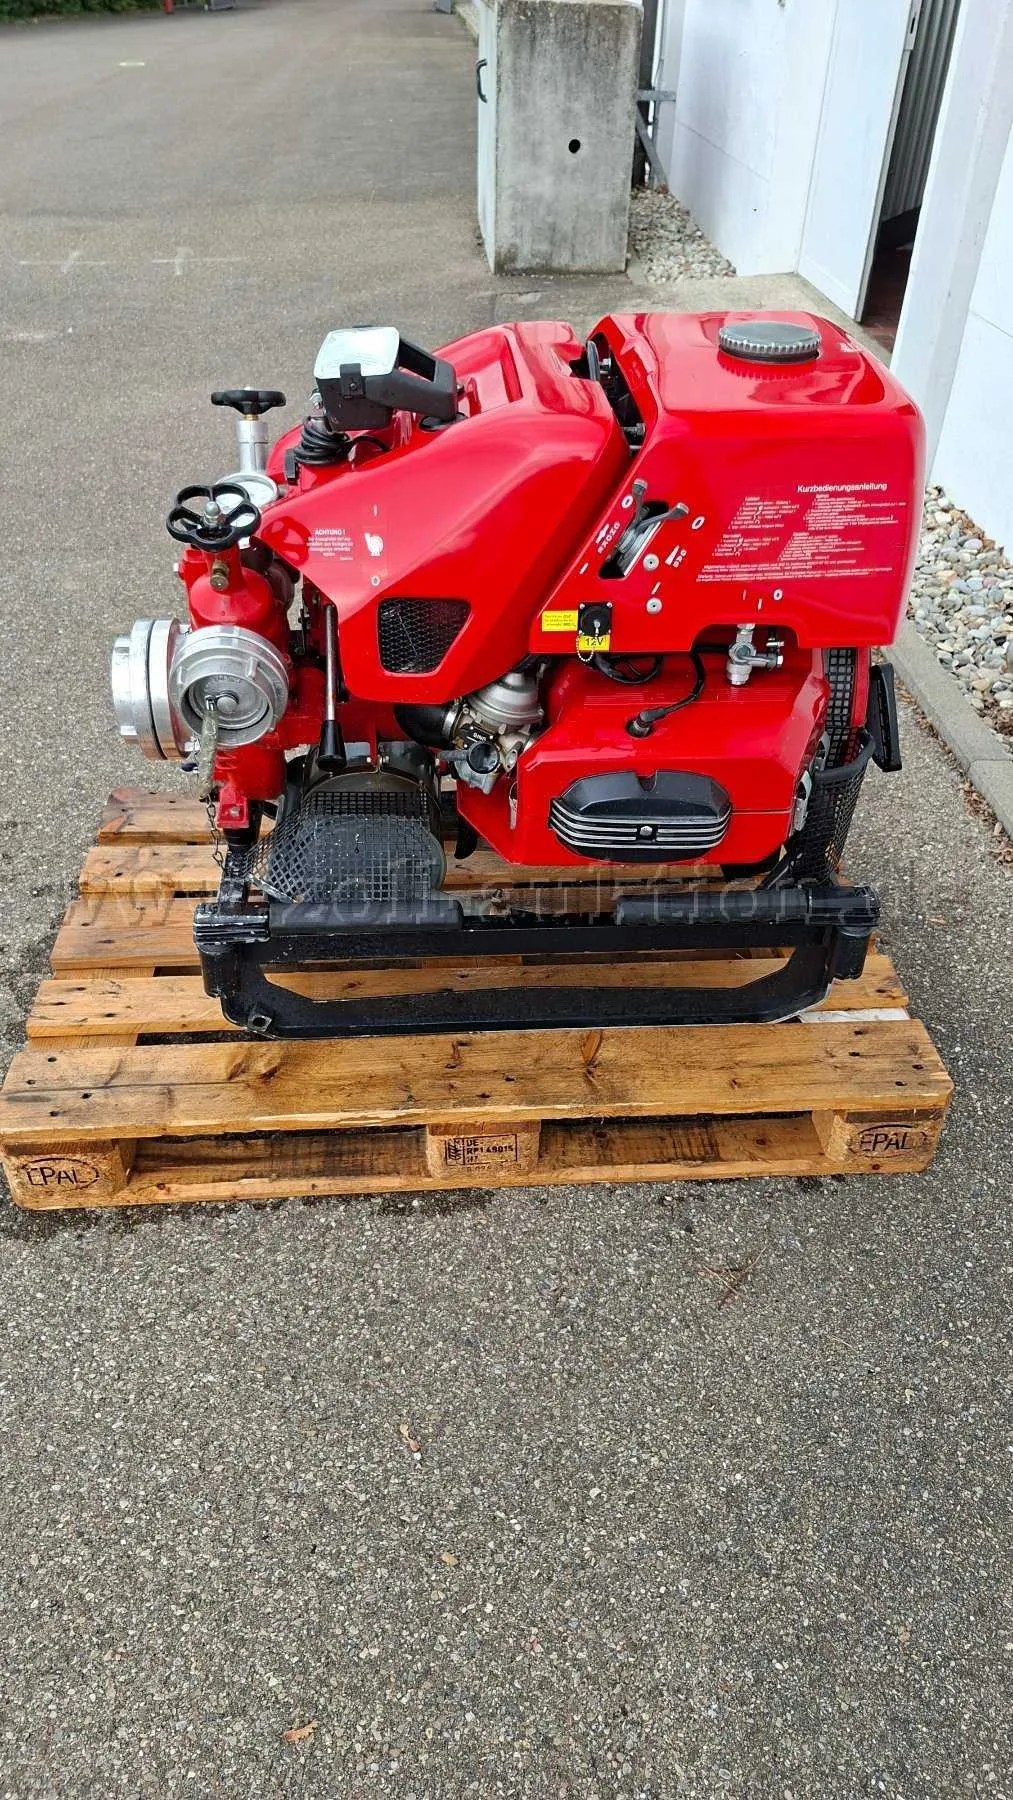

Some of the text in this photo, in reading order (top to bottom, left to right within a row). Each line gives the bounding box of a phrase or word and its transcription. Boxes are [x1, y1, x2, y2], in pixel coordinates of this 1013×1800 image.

[797, 483, 888, 493] Kurzbedienungsanleitung
[585, 637, 604, 647] 12V
[860, 1130, 914, 1152] EPAL
[26, 1166, 89, 1186] EPAL
